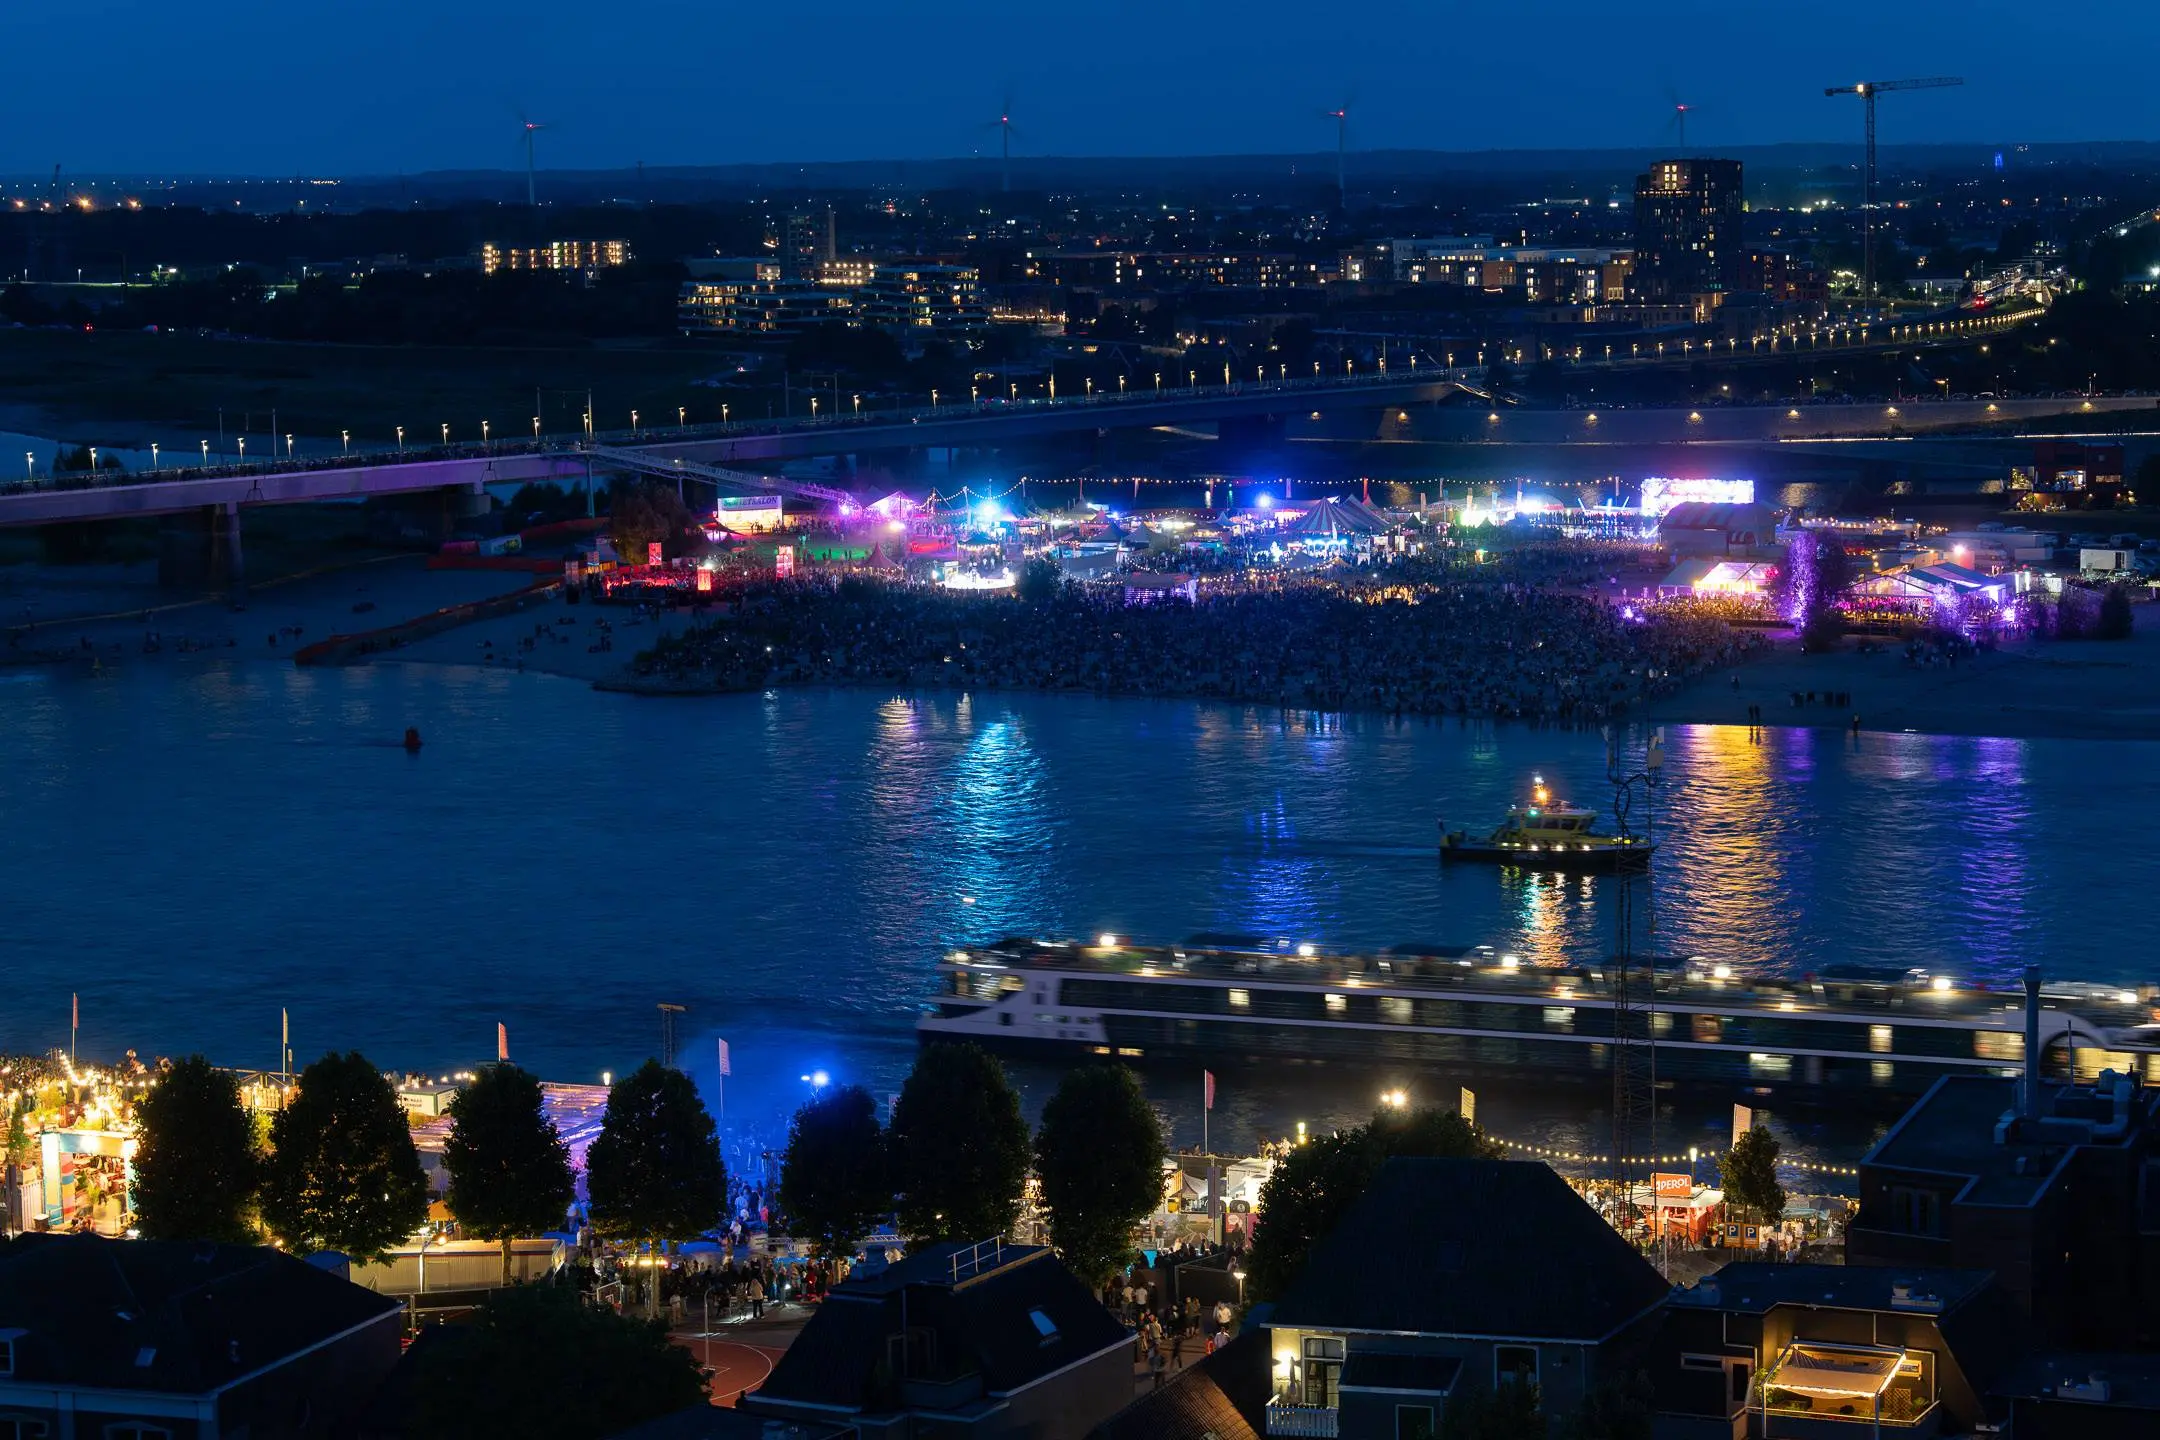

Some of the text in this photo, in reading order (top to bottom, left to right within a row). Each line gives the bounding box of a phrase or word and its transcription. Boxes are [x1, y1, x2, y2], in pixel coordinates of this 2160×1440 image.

[724, 496, 778, 506] SIETSALON
[1656, 1178, 1690, 1191] APEROL
[1729, 1225, 1737, 1236] P
[1747, 1227, 1755, 1237] P
